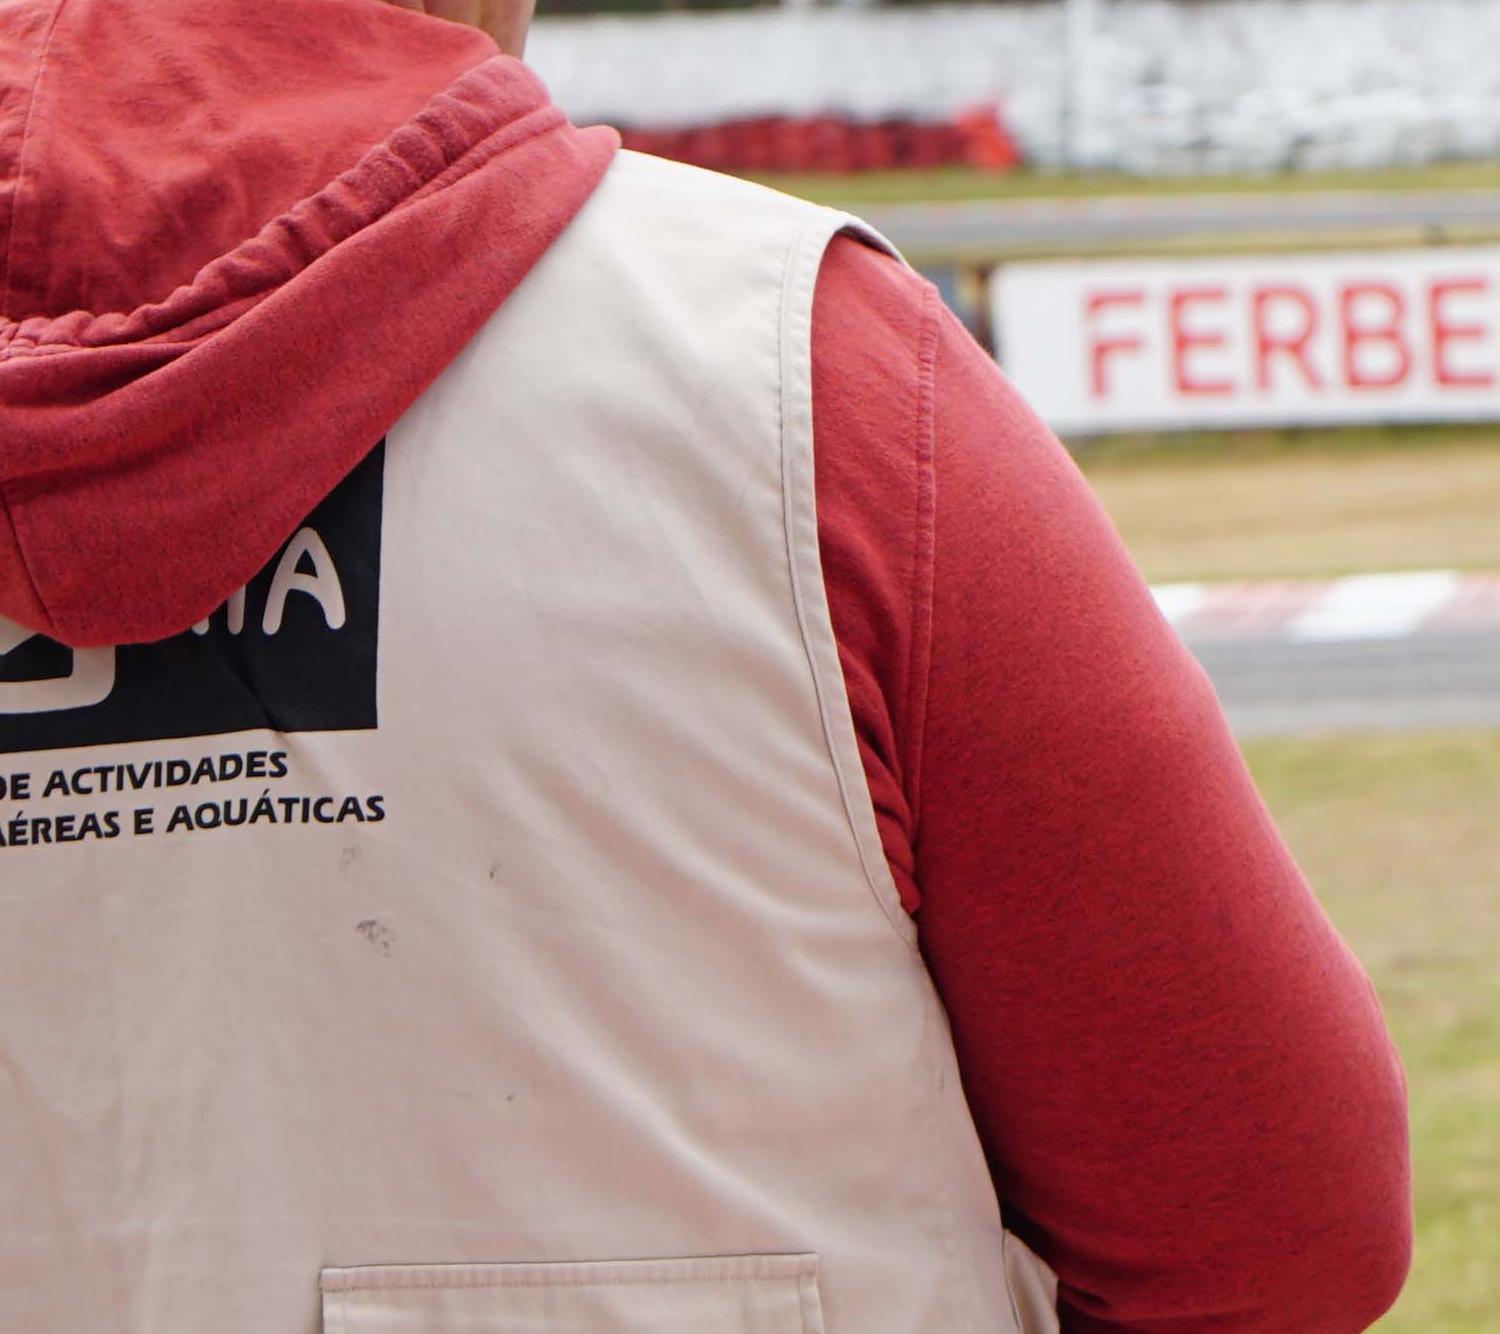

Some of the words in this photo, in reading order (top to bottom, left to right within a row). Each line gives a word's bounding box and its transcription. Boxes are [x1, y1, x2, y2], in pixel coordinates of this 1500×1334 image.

[42, 749, 290, 799] ACTIVIDADES
[132, 806, 156, 837] E
[169, 787, 387, 834] AQUÁTICAS
